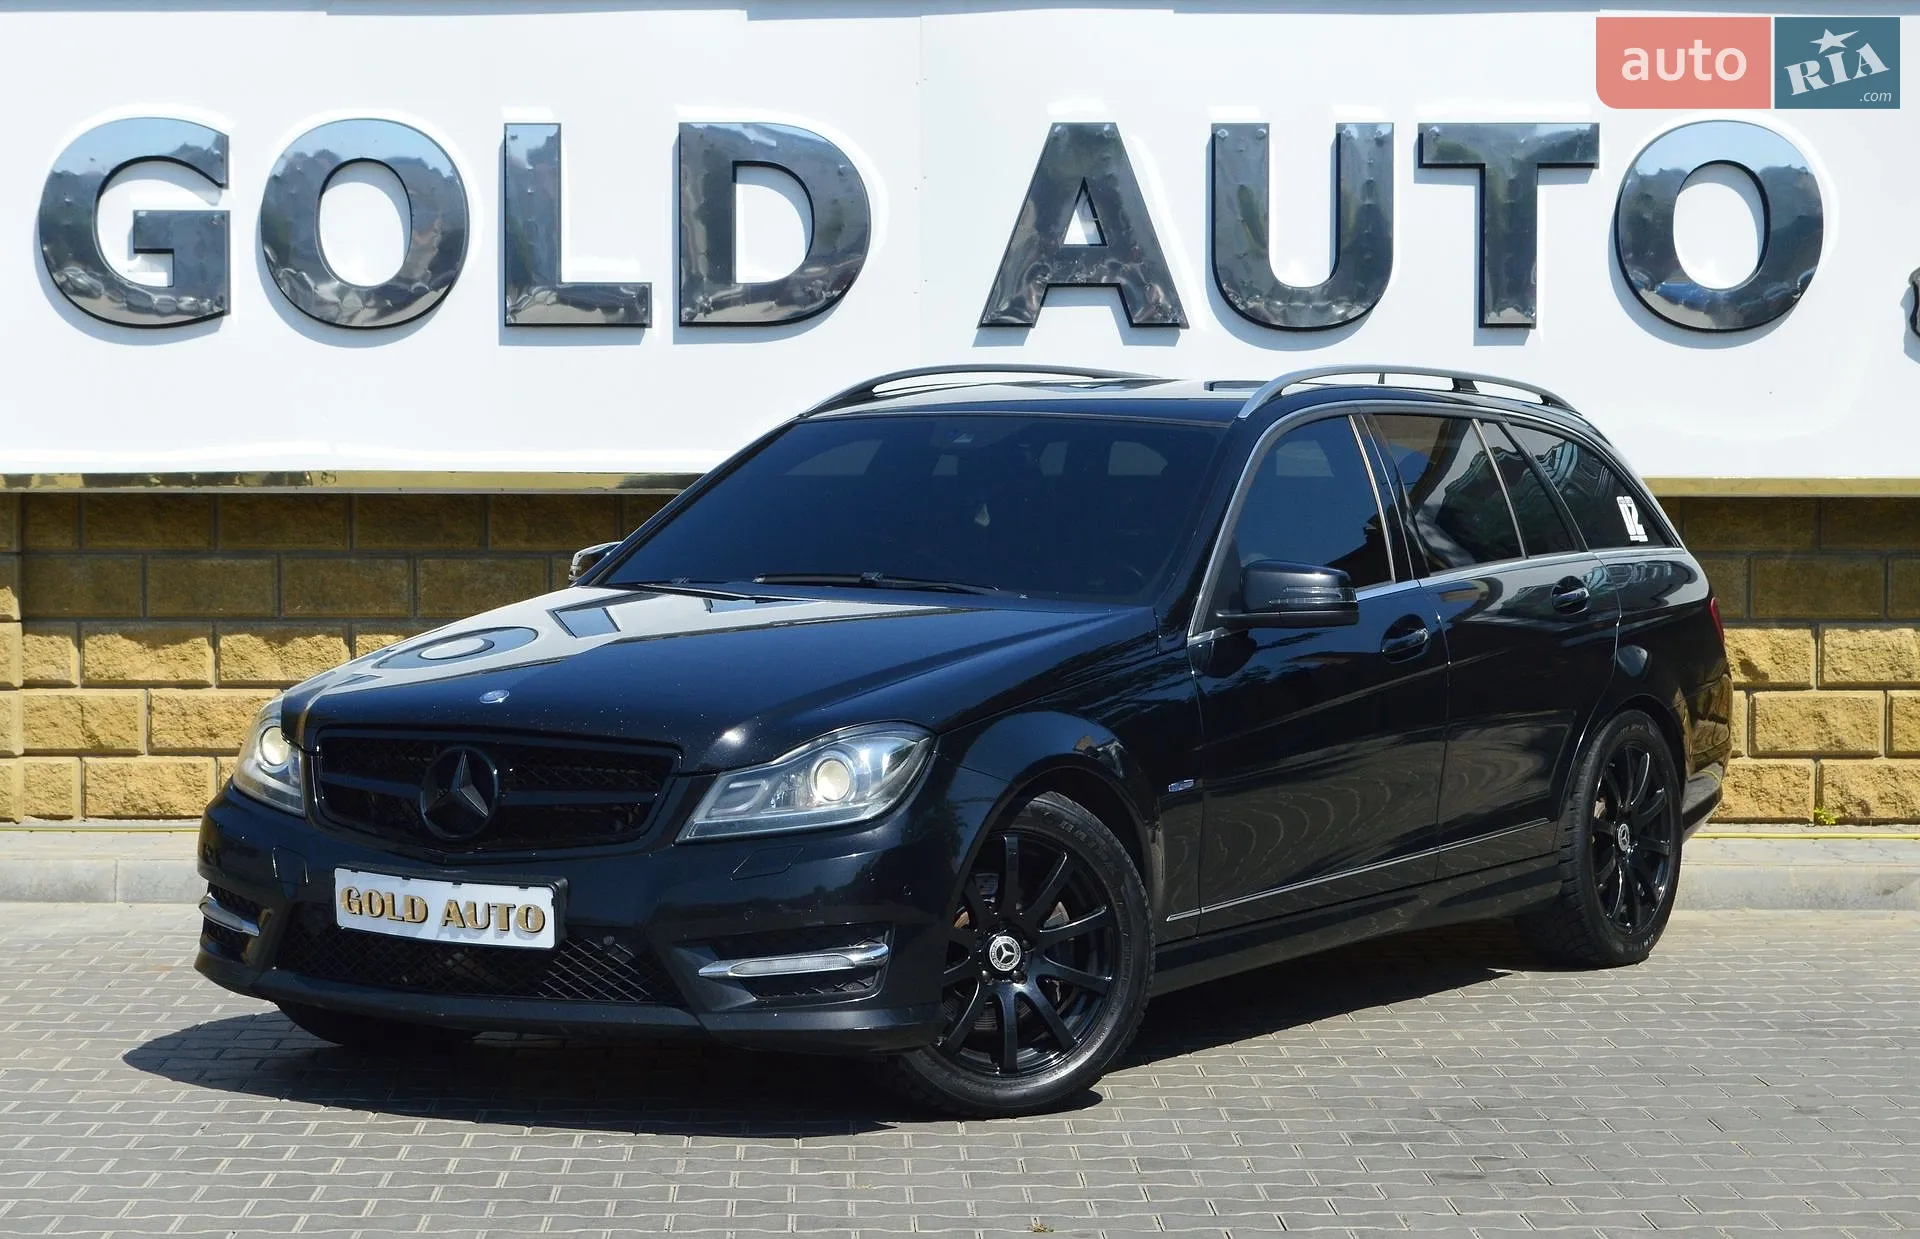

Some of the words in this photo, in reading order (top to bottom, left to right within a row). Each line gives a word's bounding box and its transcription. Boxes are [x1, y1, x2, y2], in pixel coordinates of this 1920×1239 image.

[38, 116, 872, 329] GOLD
[979, 119, 1825, 332] AUTO
[341, 886, 429, 923] GOLD
[442, 899, 546, 933] AUTO
